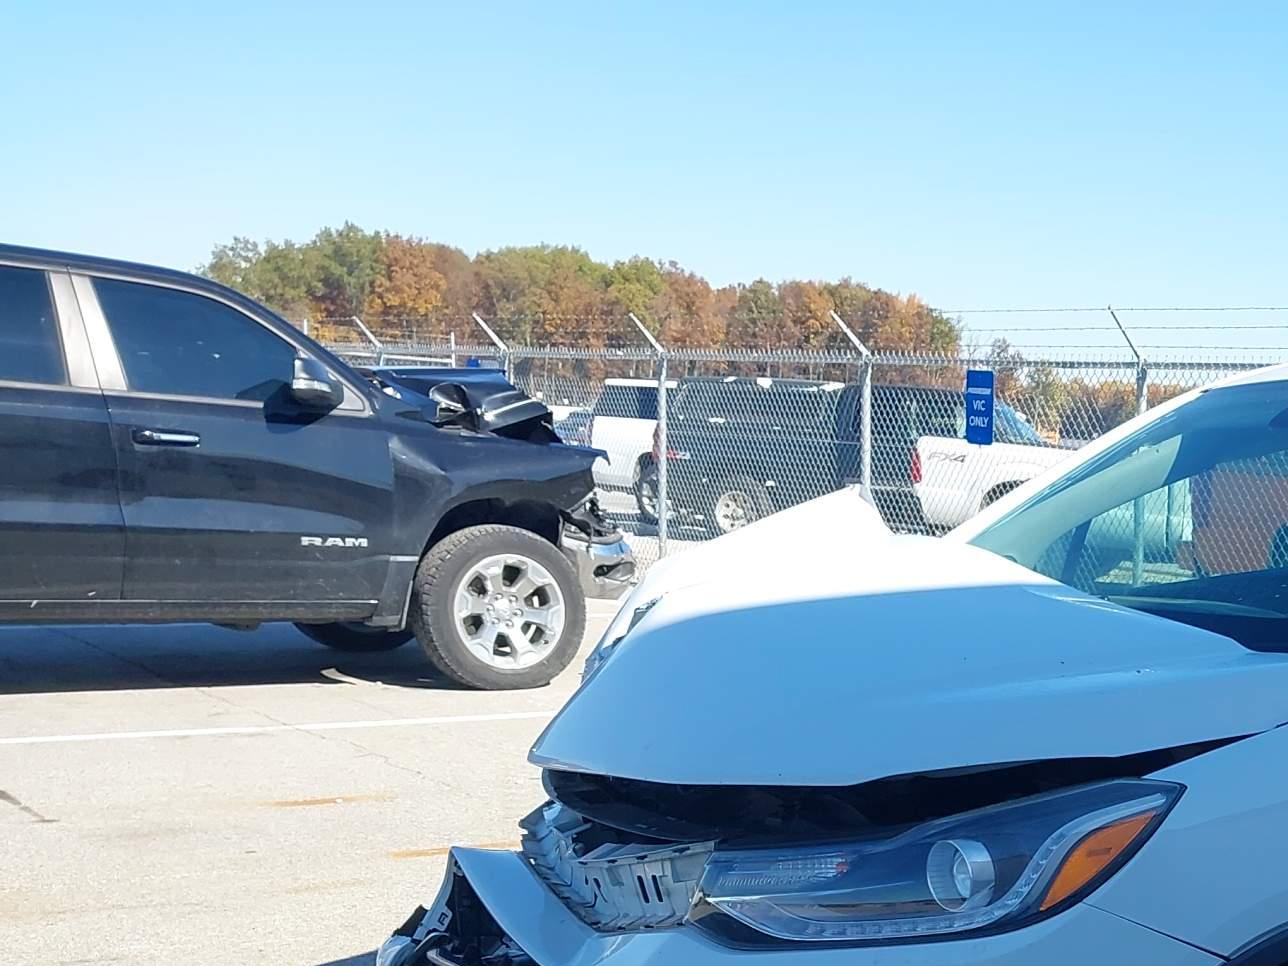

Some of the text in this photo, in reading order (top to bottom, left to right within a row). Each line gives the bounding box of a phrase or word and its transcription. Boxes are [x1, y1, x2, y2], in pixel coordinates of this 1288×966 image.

[972, 399, 986, 411] VIC
[969, 415, 989, 427] ONLY
[300, 536, 368, 547] RAM
